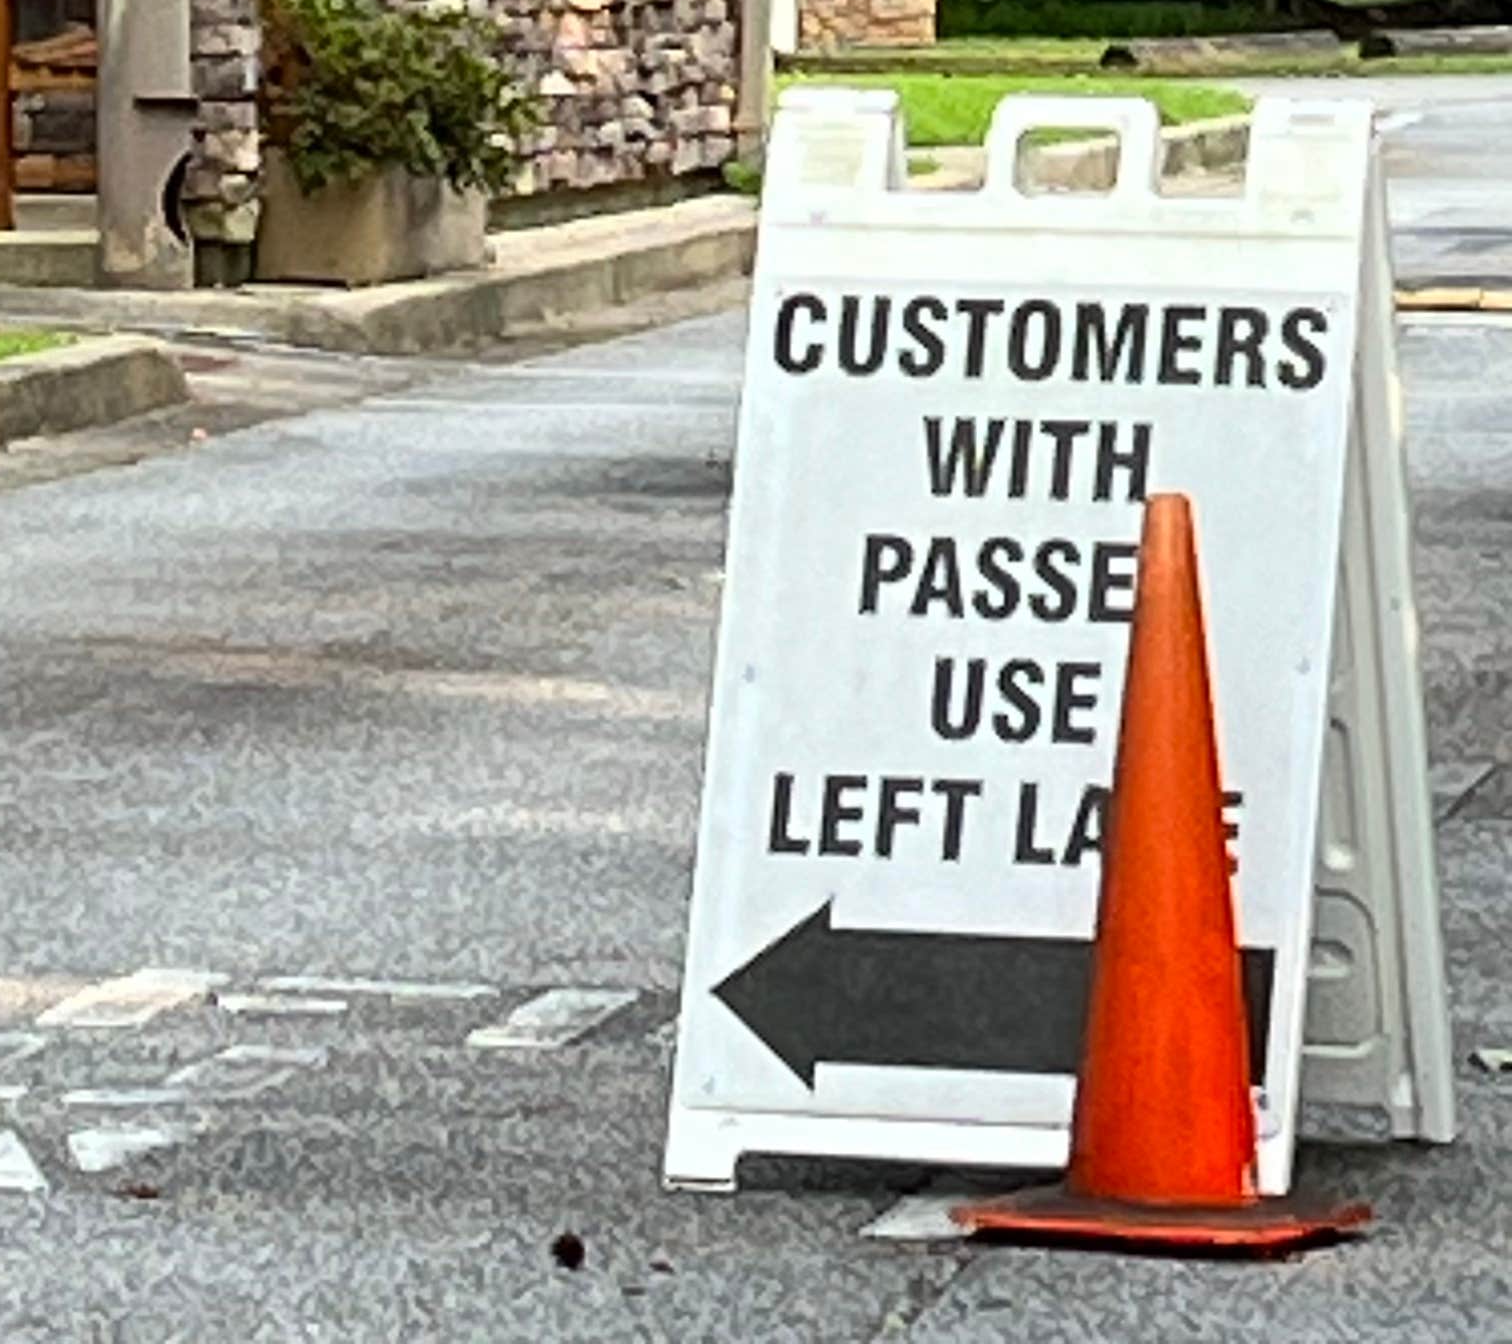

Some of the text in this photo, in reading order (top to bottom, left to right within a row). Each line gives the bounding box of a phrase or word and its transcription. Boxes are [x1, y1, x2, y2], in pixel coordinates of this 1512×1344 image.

[774, 294, 1328, 389] CUSTOMERS
[923, 416, 1152, 502] WITH
[859, 535, 1140, 622] PASSE
[932, 658, 1101, 743] USE
[767, 772, 1243, 875] LEFT LA
